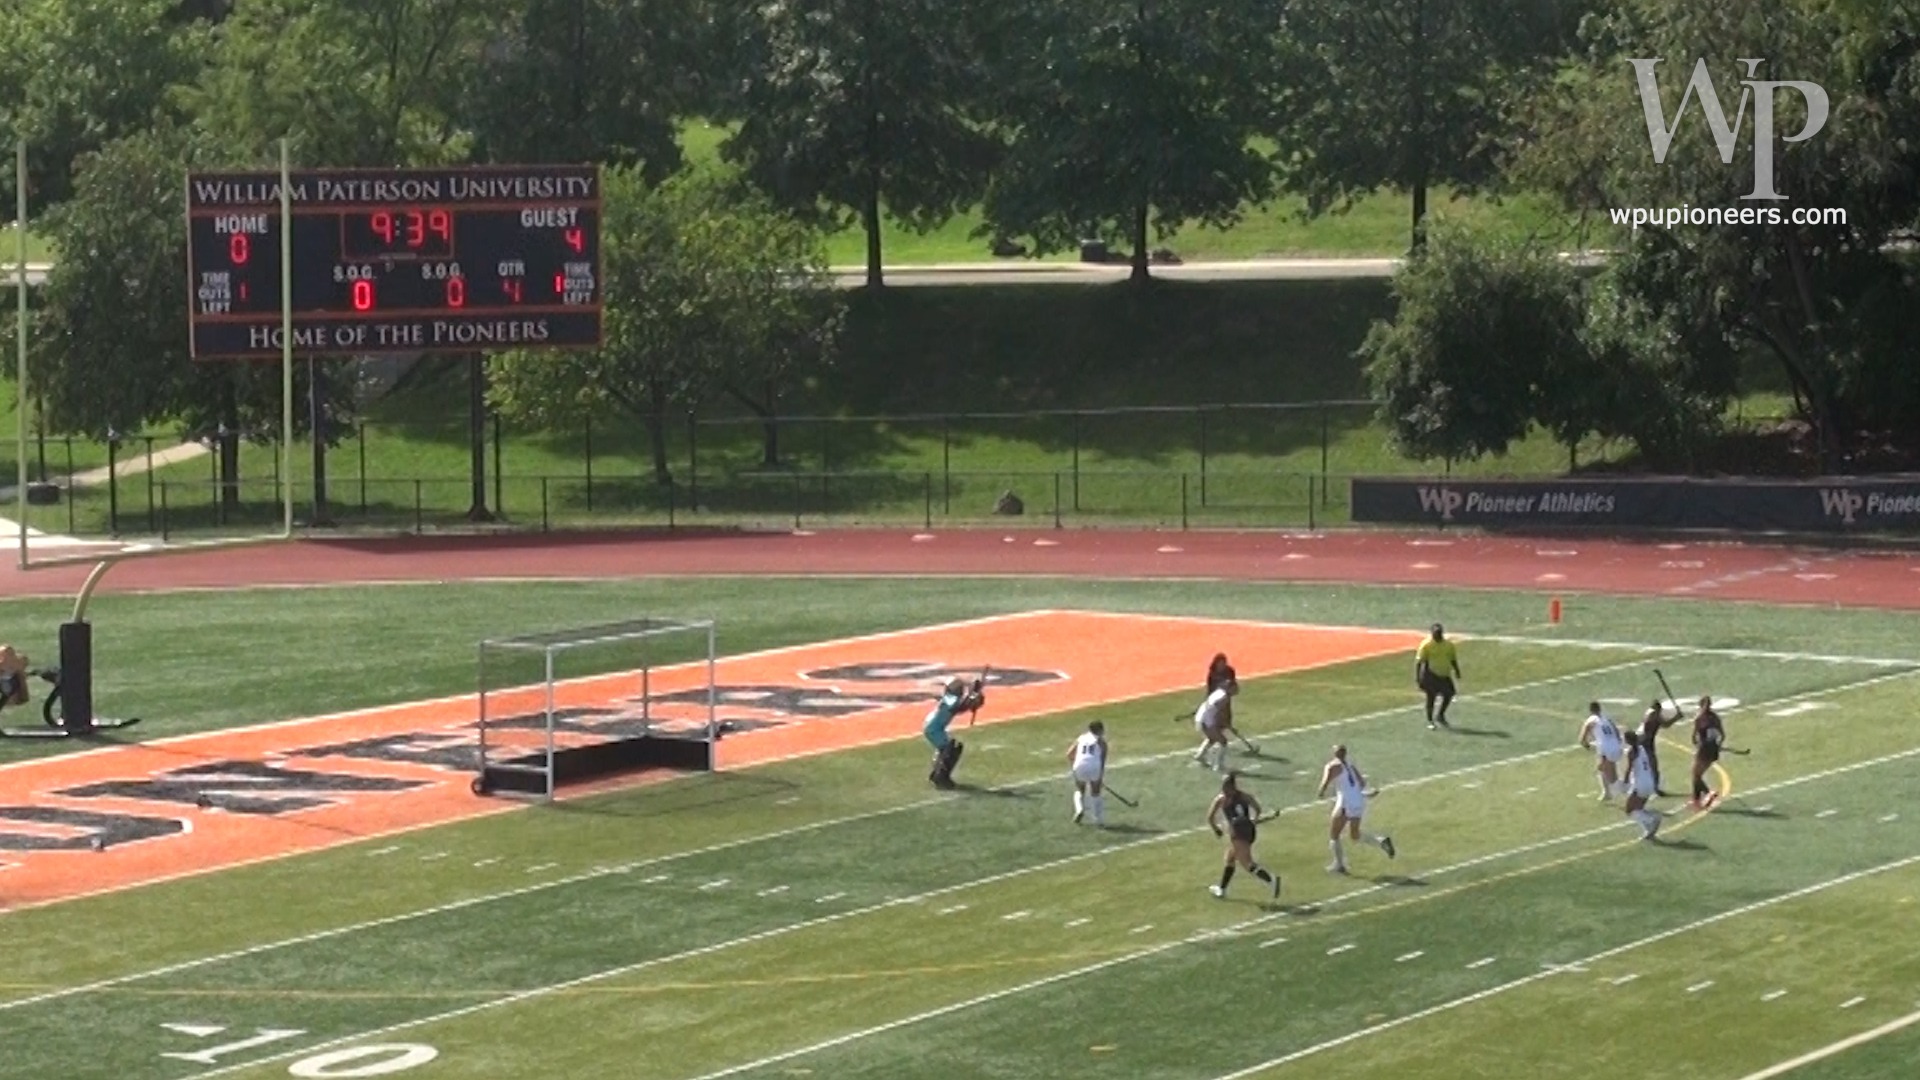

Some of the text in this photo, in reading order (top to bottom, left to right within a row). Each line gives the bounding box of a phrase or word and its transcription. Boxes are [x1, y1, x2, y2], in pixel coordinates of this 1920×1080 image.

[194, 176, 593, 204] WILLIAM PATERSON UNIVERSITY
[215, 213, 268, 235] HOME
[371, 210, 449, 248] 9:39
[521, 207, 579, 228] GUEST
[230, 234, 248, 264] 0
[564, 228, 583, 253] 4
[201, 271, 230, 284] TIME
[333, 265, 377, 282] S.O.G.
[497, 262, 525, 276] QTR
[354, 280, 371, 310] 0
[447, 278, 464, 307] 0
[202, 301, 231, 314] LEFT
[250, 319, 549, 349] HOME OF THE PIONEERS
[1465, 491, 1536, 513] Pioneer
[1538, 491, 1615, 513] Athletics
